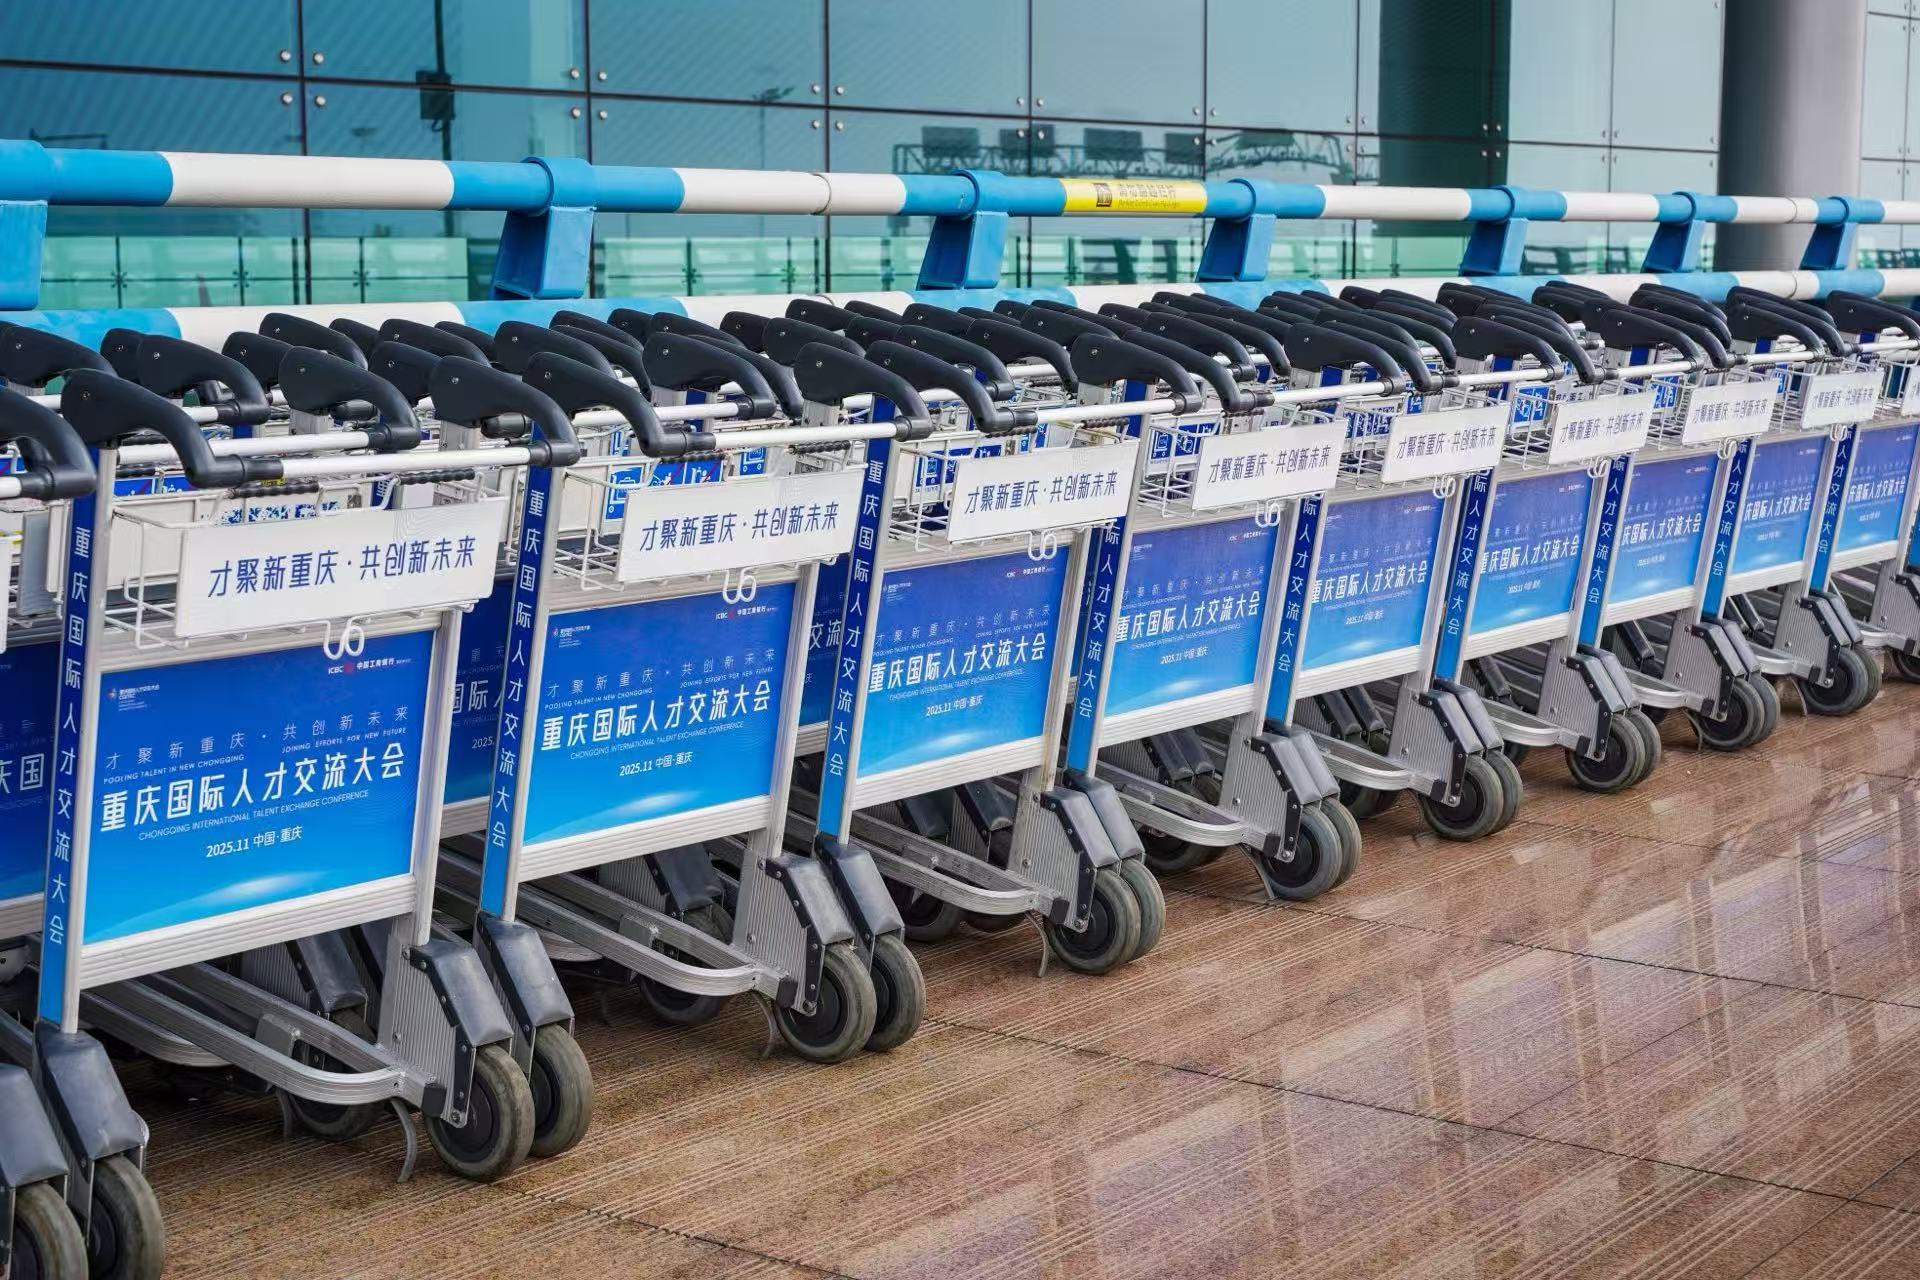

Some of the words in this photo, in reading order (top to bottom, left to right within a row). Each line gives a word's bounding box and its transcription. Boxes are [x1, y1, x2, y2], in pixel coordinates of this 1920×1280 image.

[964, 470, 1119, 514] 才聚新重庆·共创新未来
[1208, 445, 1332, 484] 才聚新重庆·共创新未来
[640, 501, 839, 552] 才聚新重庆·共创新未来
[207, 535, 477, 599] 才聚新重庆·共创新未来
[829, 460, 884, 778] 重庆国际人才交流大会
[1114, 591, 1260, 643] 重庆国际人才交流大会
[492, 490, 545, 848] 重庆国际人才交流大会
[868, 632, 1046, 694] 重庆国际人才交流大会
[48, 526, 92, 946] 重庆国际人才交流大会
[105, 705, 409, 770] 才聚新重庆·共创新未来
[540, 680, 771, 751] 重庆国际人才交流大会
[100, 742, 405, 832] 重庆国际人才交流大会
[103, 771, 138, 784] POOLING
[141, 767, 167, 778] TALENT
[180, 762, 196, 773] NEW
[197, 754, 245, 769] CHONGQING
[619, 760, 653, 776] 2025.11
[655, 751, 693, 768] 中国·重庆
[138, 823, 191, 841] CHONGQING
[192, 813, 250, 830] INTERNATIONAL
[253, 807, 279, 819] TALENT
[280, 798, 320, 813] EXCHANGE
[321, 789, 369, 807] CONFERENCE
[206, 838, 250, 858] 2025.11
[253, 826, 303, 848] 中国·重庆
